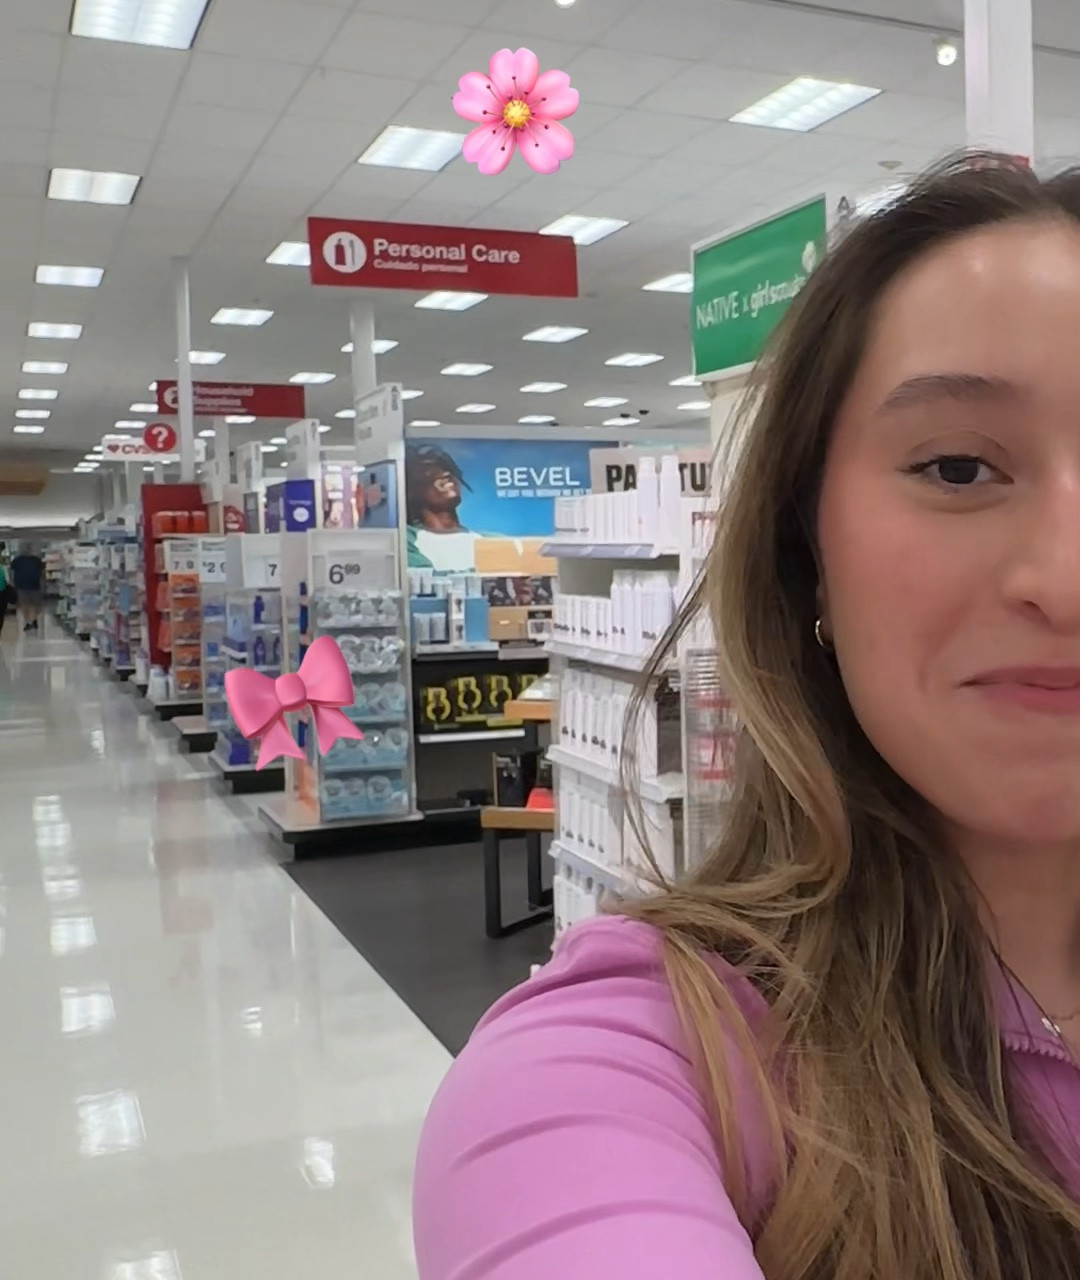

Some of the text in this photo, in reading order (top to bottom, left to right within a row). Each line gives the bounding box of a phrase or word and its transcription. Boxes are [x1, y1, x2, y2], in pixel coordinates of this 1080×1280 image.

[373, 238, 521, 264] Personal Care
[696, 290, 740, 330] NATIVE
[494, 466, 581, 487] BEVEL
